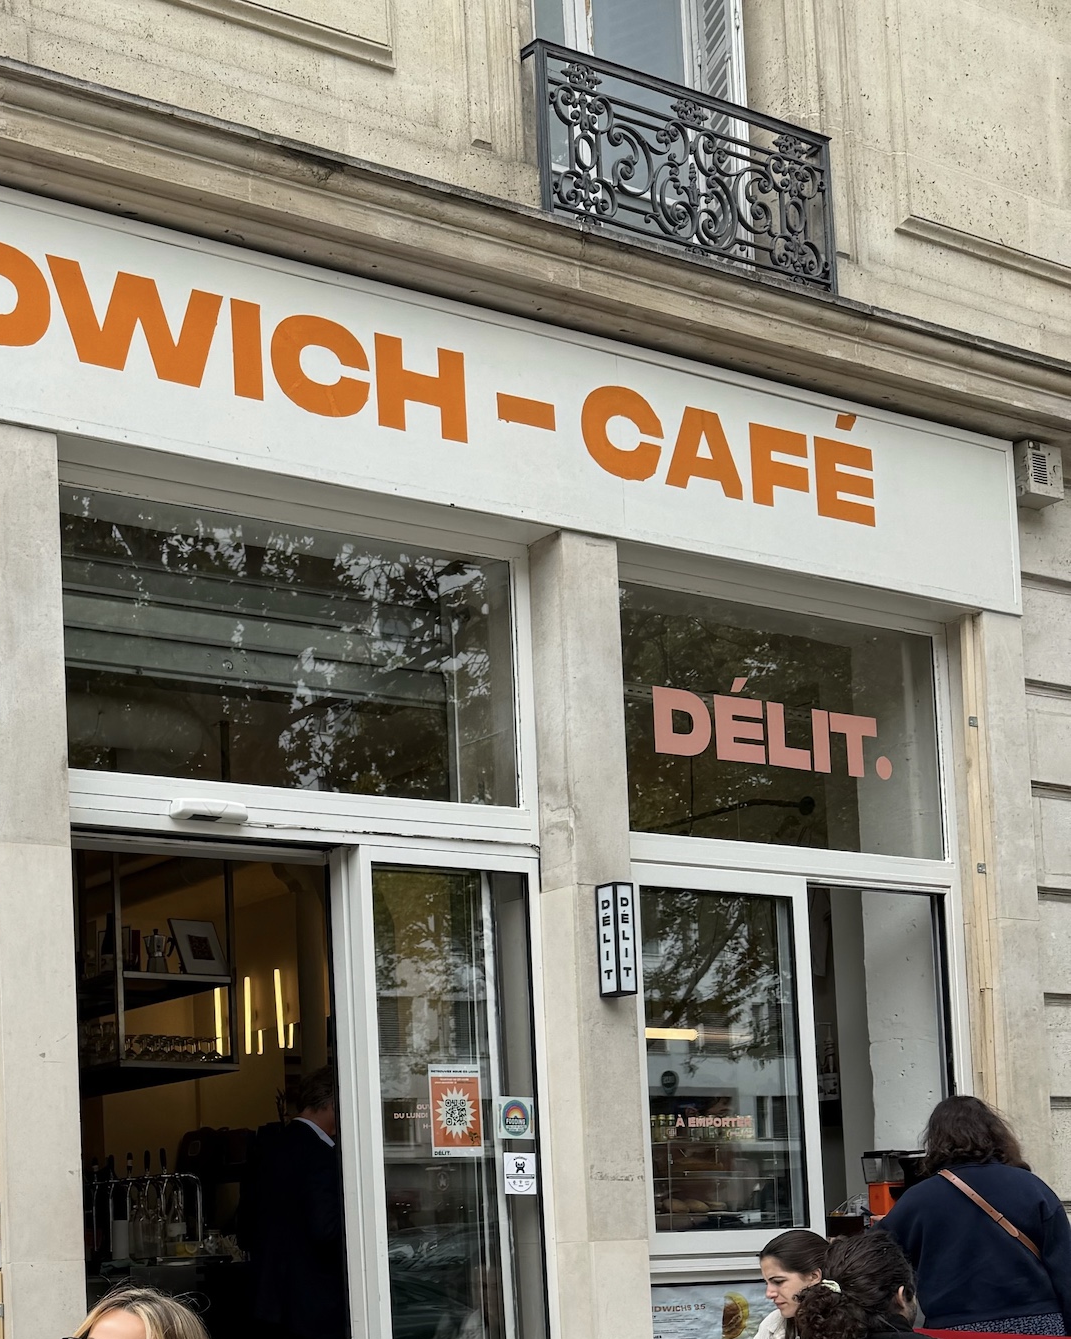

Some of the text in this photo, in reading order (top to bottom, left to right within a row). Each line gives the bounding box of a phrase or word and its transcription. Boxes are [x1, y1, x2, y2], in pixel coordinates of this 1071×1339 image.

[582, 387, 875, 525] CAFÉ
[652, 677, 892, 780] DÉLIT.
[601, 899, 614, 980] DÉLIT
[619, 896, 633, 978] DÉLIT
[406, 1111, 429, 1119] LUNDI
[675, 1113, 753, 1128] À EMPORTER
